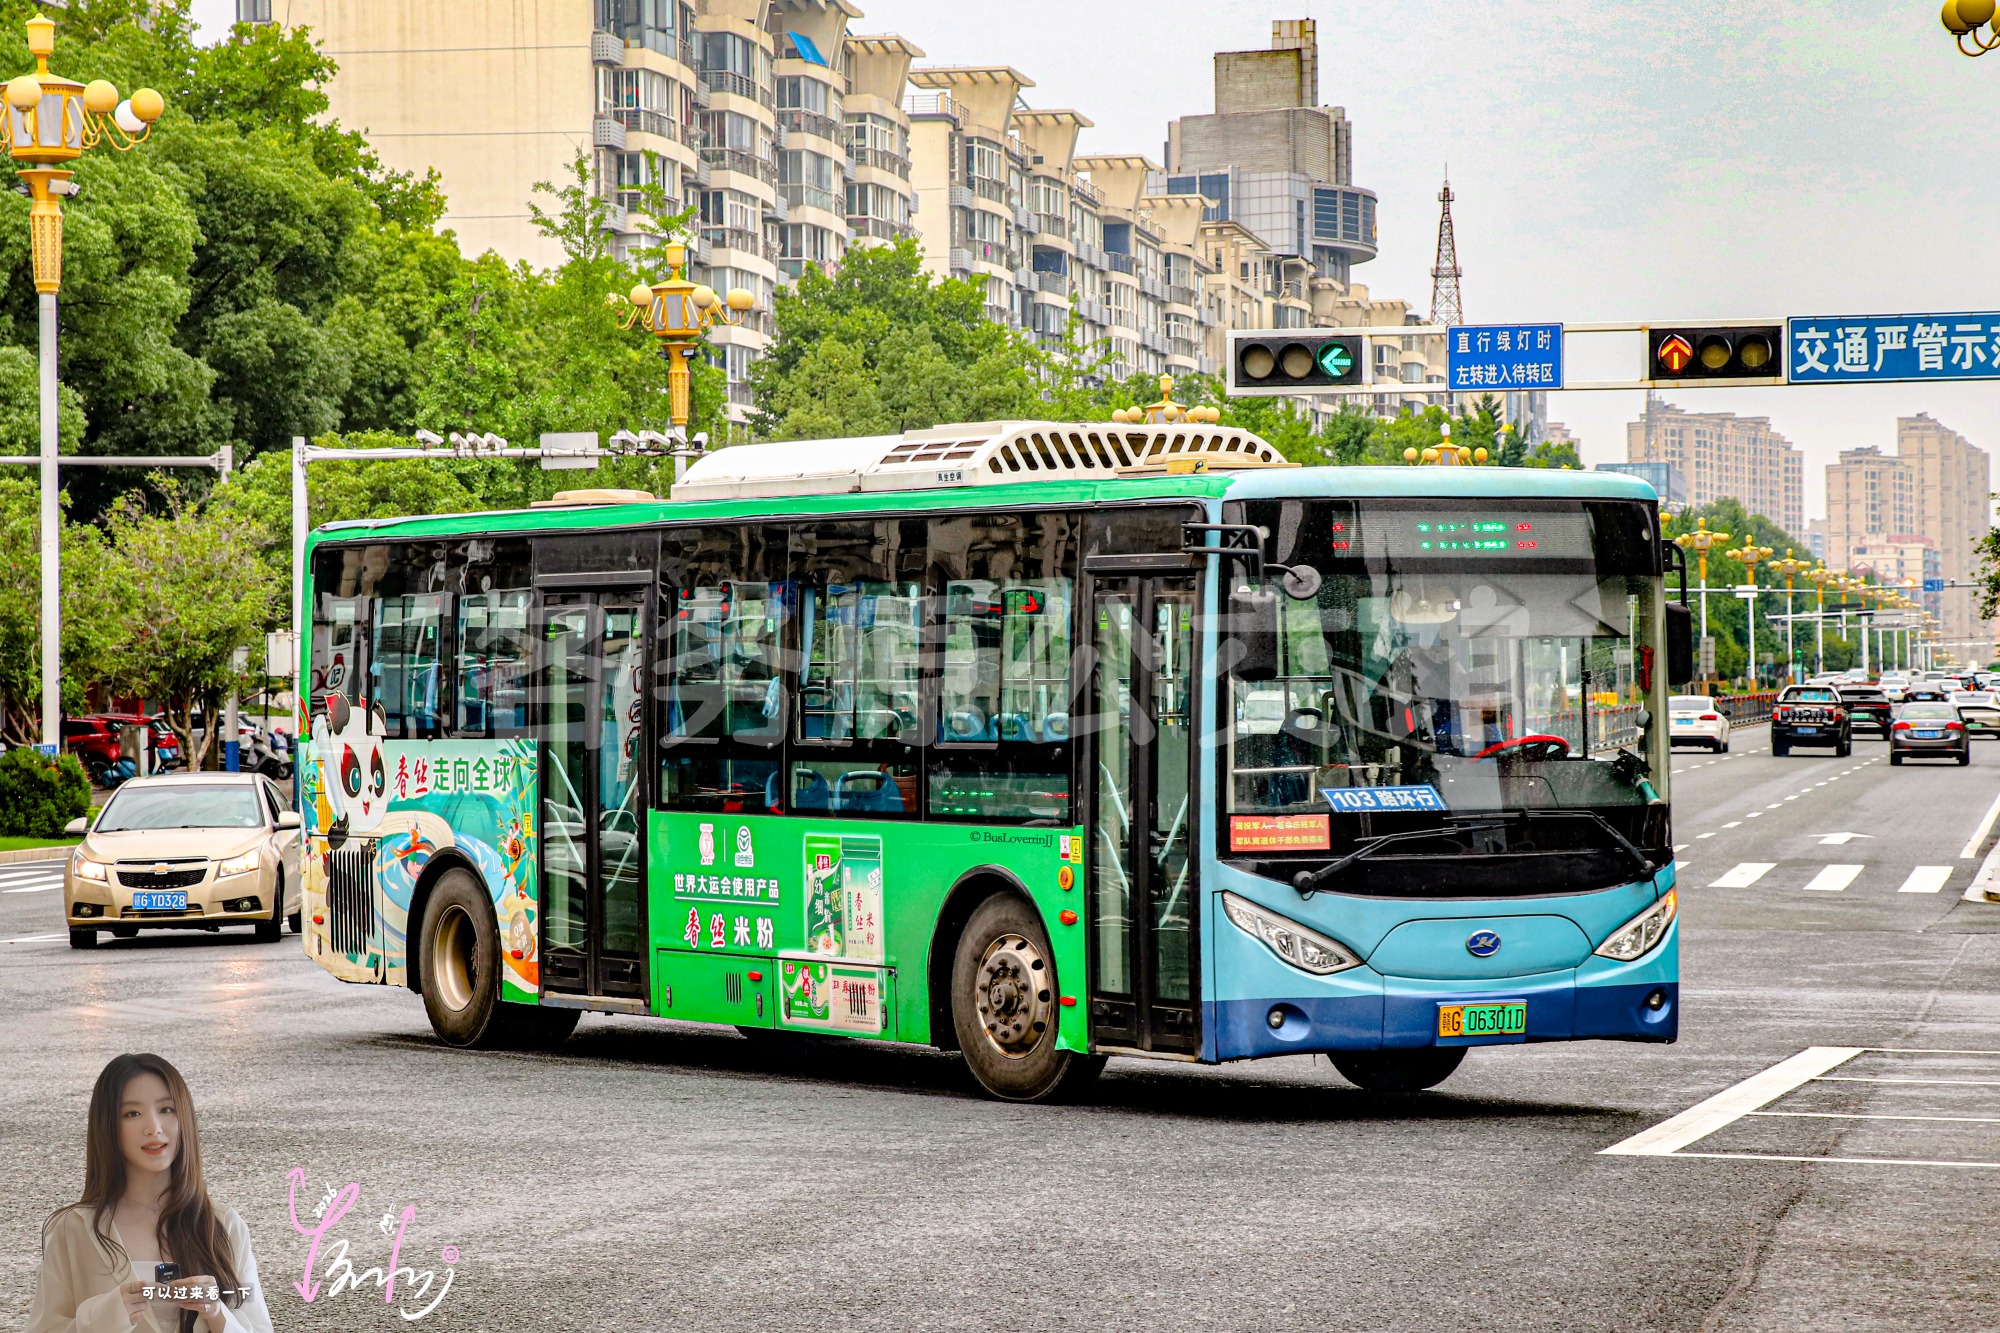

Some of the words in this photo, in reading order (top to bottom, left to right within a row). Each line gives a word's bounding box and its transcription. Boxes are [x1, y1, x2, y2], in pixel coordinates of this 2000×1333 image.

[1456, 329, 1552, 353] 直行绿灯时
[1795, 322, 2000, 374] 交通严管示
[1456, 362, 1553, 386] 左转进入待转区
[674, 873, 780, 899] 世界大运会使用产品
[683, 906, 774, 948] 春丝米粉
